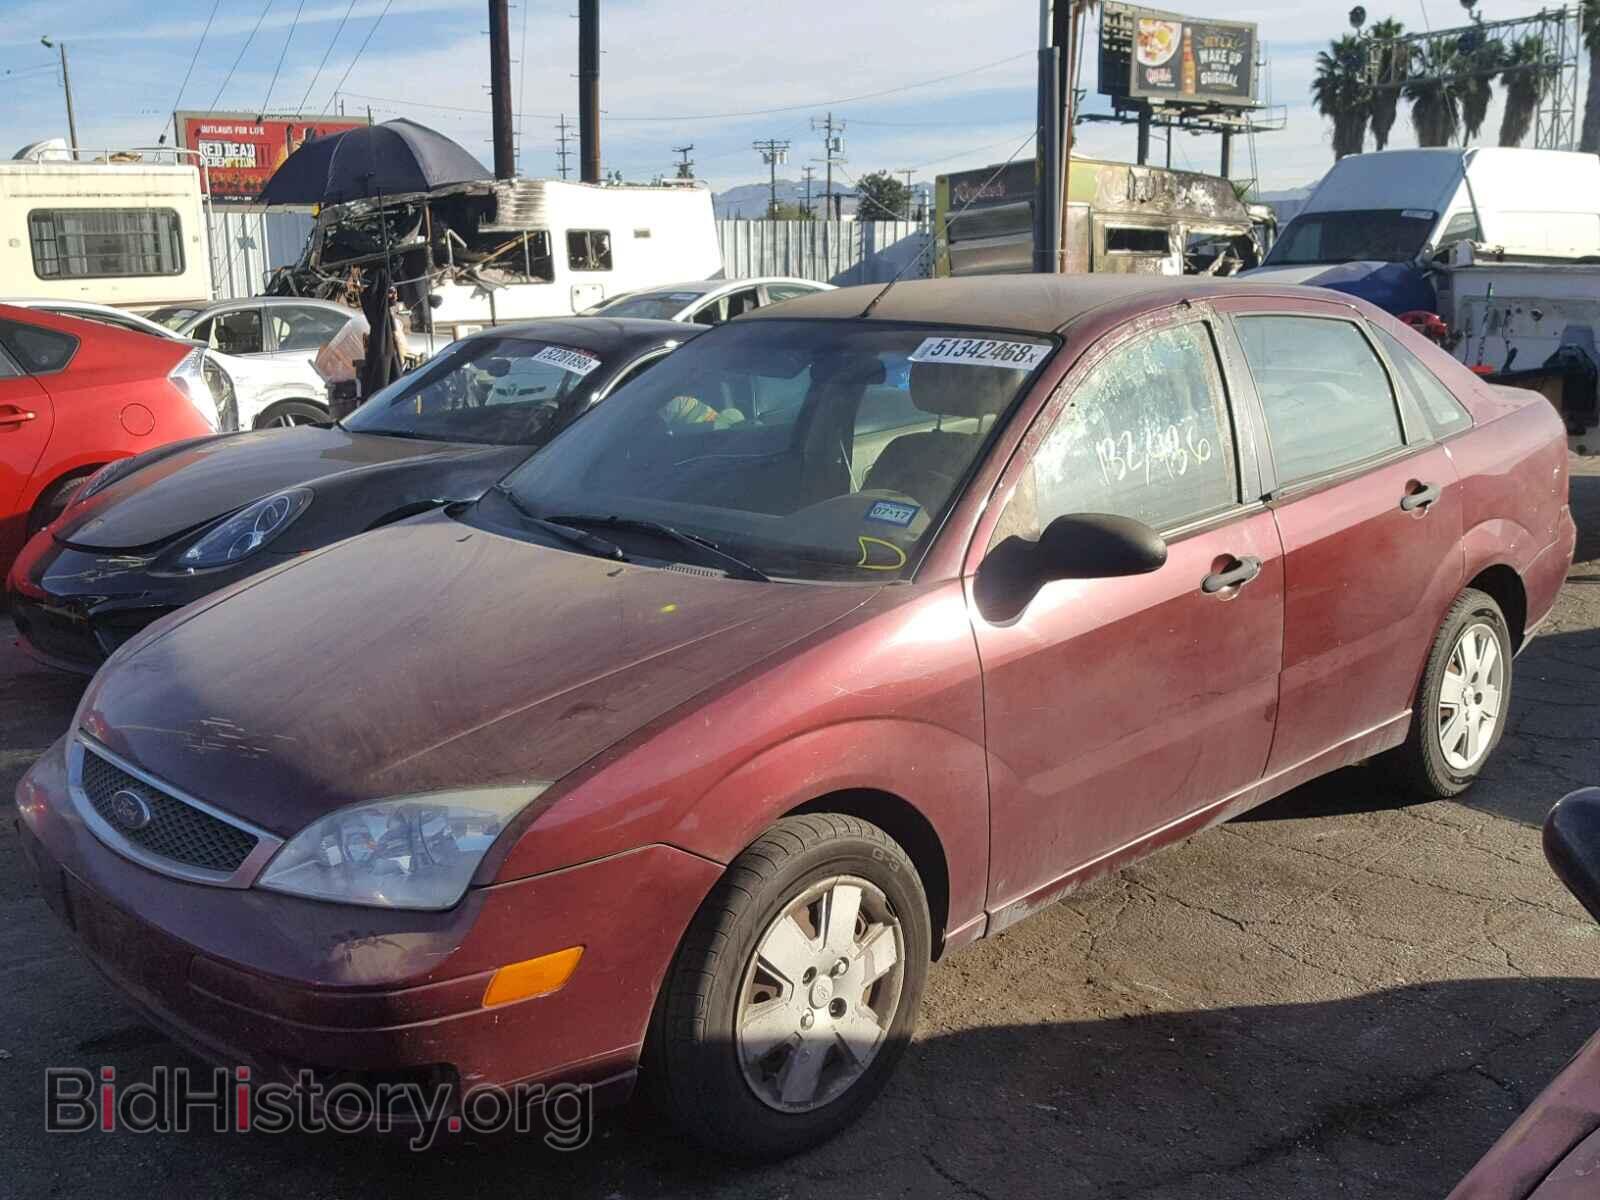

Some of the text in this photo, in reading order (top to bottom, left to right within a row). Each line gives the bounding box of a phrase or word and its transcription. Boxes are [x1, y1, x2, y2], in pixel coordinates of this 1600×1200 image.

[235, 125, 248, 135] FOR
[249, 126, 264, 136] LIFE
[200, 142, 222, 157] RED
[224, 143, 256, 158] DEAD
